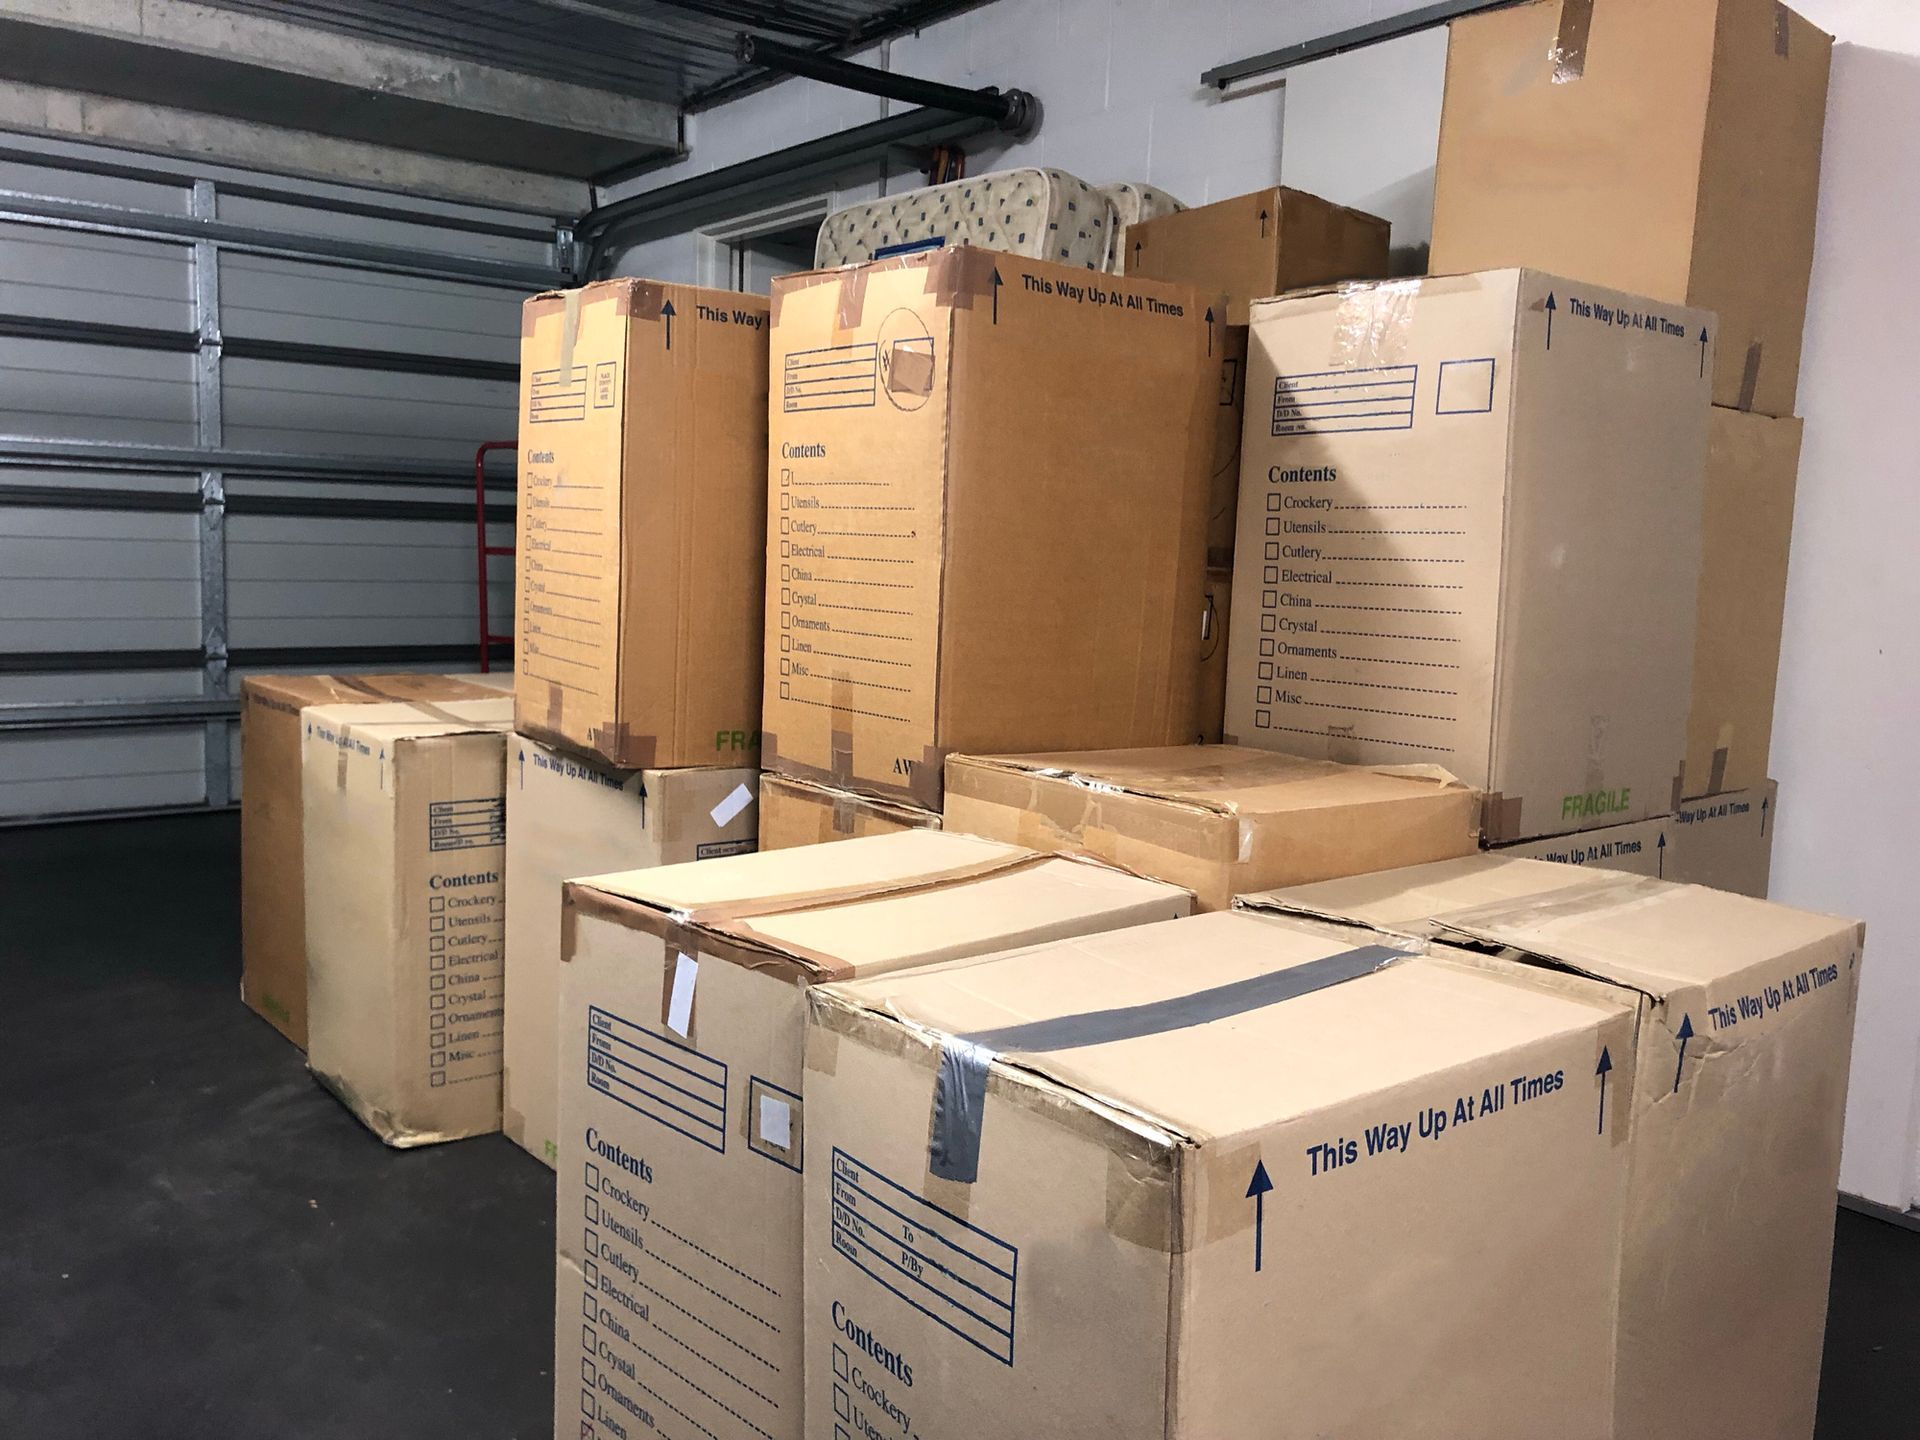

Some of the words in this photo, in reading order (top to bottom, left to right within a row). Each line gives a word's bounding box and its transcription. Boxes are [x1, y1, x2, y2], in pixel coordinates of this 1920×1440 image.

[1021, 274, 1052, 294] This
[1056, 280, 1084, 303] Way
[1088, 287, 1106, 307] Up
[1109, 292, 1123, 308] At
[1127, 294, 1142, 311] All
[1146, 297, 1184, 317] Times
[696, 305, 728, 323] This
[732, 310, 762, 330] Way
[1569, 298, 1591, 319] This
[1594, 304, 1614, 326] Way
[1616, 309, 1630, 328] Up
[1632, 313, 1643, 329] At
[1644, 315, 1657, 332] All
[1660, 318, 1685, 338] Times
[1279, 381, 1299, 390] Client
[527, 449, 554, 464] Contents
[782, 442, 826, 459] Contents
[1268, 466, 1337, 484] Contents
[791, 496, 820, 509] Utensils
[1284, 496, 1333, 511] Crockery
[791, 520, 817, 536] Cutlery
[1283, 520, 1326, 534] Utensils
[791, 544, 825, 558] Electrical
[1282, 545, 1321, 561] Cutlery
[792, 568, 812, 581] China
[1281, 569, 1332, 584] Electrical
[792, 591, 817, 607] Crystal
[1280, 593, 1312, 608] China
[792, 615, 830, 632] Ornaments
[1279, 617, 1318, 633] Crystal
[792, 638, 812, 653] Linen
[1277, 642, 1337, 659] Ornaments
[791, 662, 809, 676] Misc
[1276, 666, 1308, 681] Linen
[1275, 689, 1303, 705] Misc
[533, 753, 548, 769] This
[549, 759, 565, 776] Way
[566, 762, 577, 779] Up
[578, 767, 587, 780] At
[588, 769, 598, 784] All
[600, 772, 624, 791] Times
[1562, 788, 1631, 820] FRAGILE
[1696, 808, 1707, 823] Up
[1708, 806, 1717, 819] At
[1718, 804, 1728, 817] All
[1729, 803, 1750, 815] Times
[1571, 849, 1585, 865] Up
[1587, 846, 1598, 861] At
[1600, 843, 1613, 858] All
[1614, 840, 1642, 856] Times
[429, 871, 499, 890] Contents
[448, 894, 496, 908] Crockery
[449, 914, 491, 928] Utensils
[448, 933, 488, 947] Cutlery
[449, 950, 499, 967] Electrical
[448, 973, 480, 986] China
[448, 989, 486, 1006] Crystal
[1708, 1004, 1737, 1031] This
[1737, 995, 1763, 1019] Way
[1764, 986, 1781, 1012] Up
[1783, 979, 1795, 1002] At
[1796, 972, 1810, 997] All
[1809, 963, 1838, 989] Times
[592, 1014, 612, 1031] Client
[449, 1031, 480, 1044] Linen
[592, 1033, 612, 1051] From
[591, 1073, 610, 1090] Room
[1306, 1138, 1358, 1176] This
[1365, 1121, 1412, 1153] Way
[1419, 1107, 1447, 1140] Up
[1452, 1097, 1475, 1128] At
[1479, 1083, 1504, 1118] All
[1510, 1069, 1564, 1105] Times
[586, 1127, 653, 1184] Contents
[836, 1157, 860, 1183] Client
[602, 1177, 650, 1221] Crockery
[836, 1182, 857, 1207] From
[902, 1224, 914, 1243] To
[602, 1209, 644, 1249] Utensils
[836, 1206, 851, 1227] D/D
[850, 1218, 866, 1239] No.
[901, 1251, 924, 1278] P/By
[836, 1231, 858, 1258] Room
[601, 1243, 640, 1284] Cutlery
[601, 1274, 649, 1321] Electrical
[600, 1308, 631, 1343] China
[832, 1300, 914, 1388] Contents
[599, 1341, 636, 1381] Crystal
[598, 1373, 655, 1428] Ornaments
[852, 1366, 911, 1434] Crockery
[598, 1404, 627, 1440] Linen
